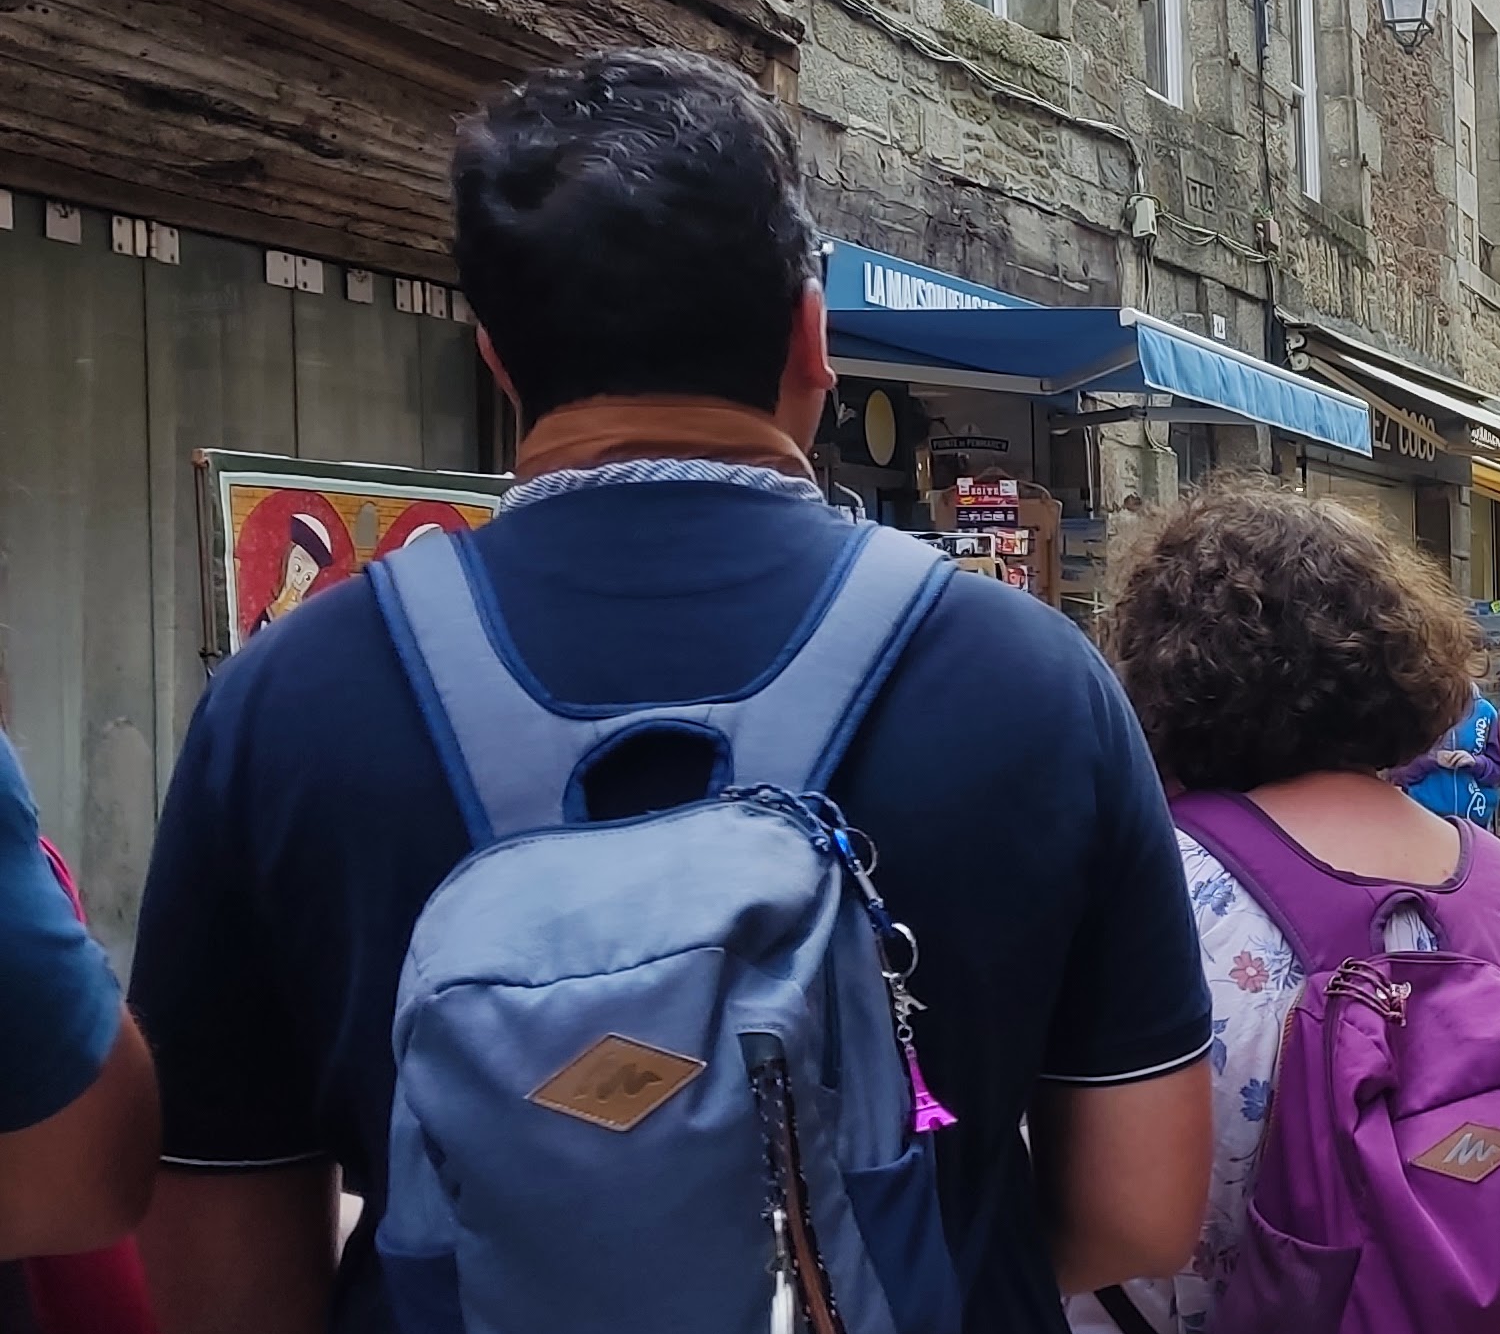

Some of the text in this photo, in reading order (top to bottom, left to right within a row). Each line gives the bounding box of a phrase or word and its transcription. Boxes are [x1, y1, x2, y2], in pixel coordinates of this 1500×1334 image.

[864, 261, 886, 307] LA
[886, 268, 947, 310] MAISON
[1373, 406, 1391, 451] EZ
[1398, 408, 1436, 462] COCO
